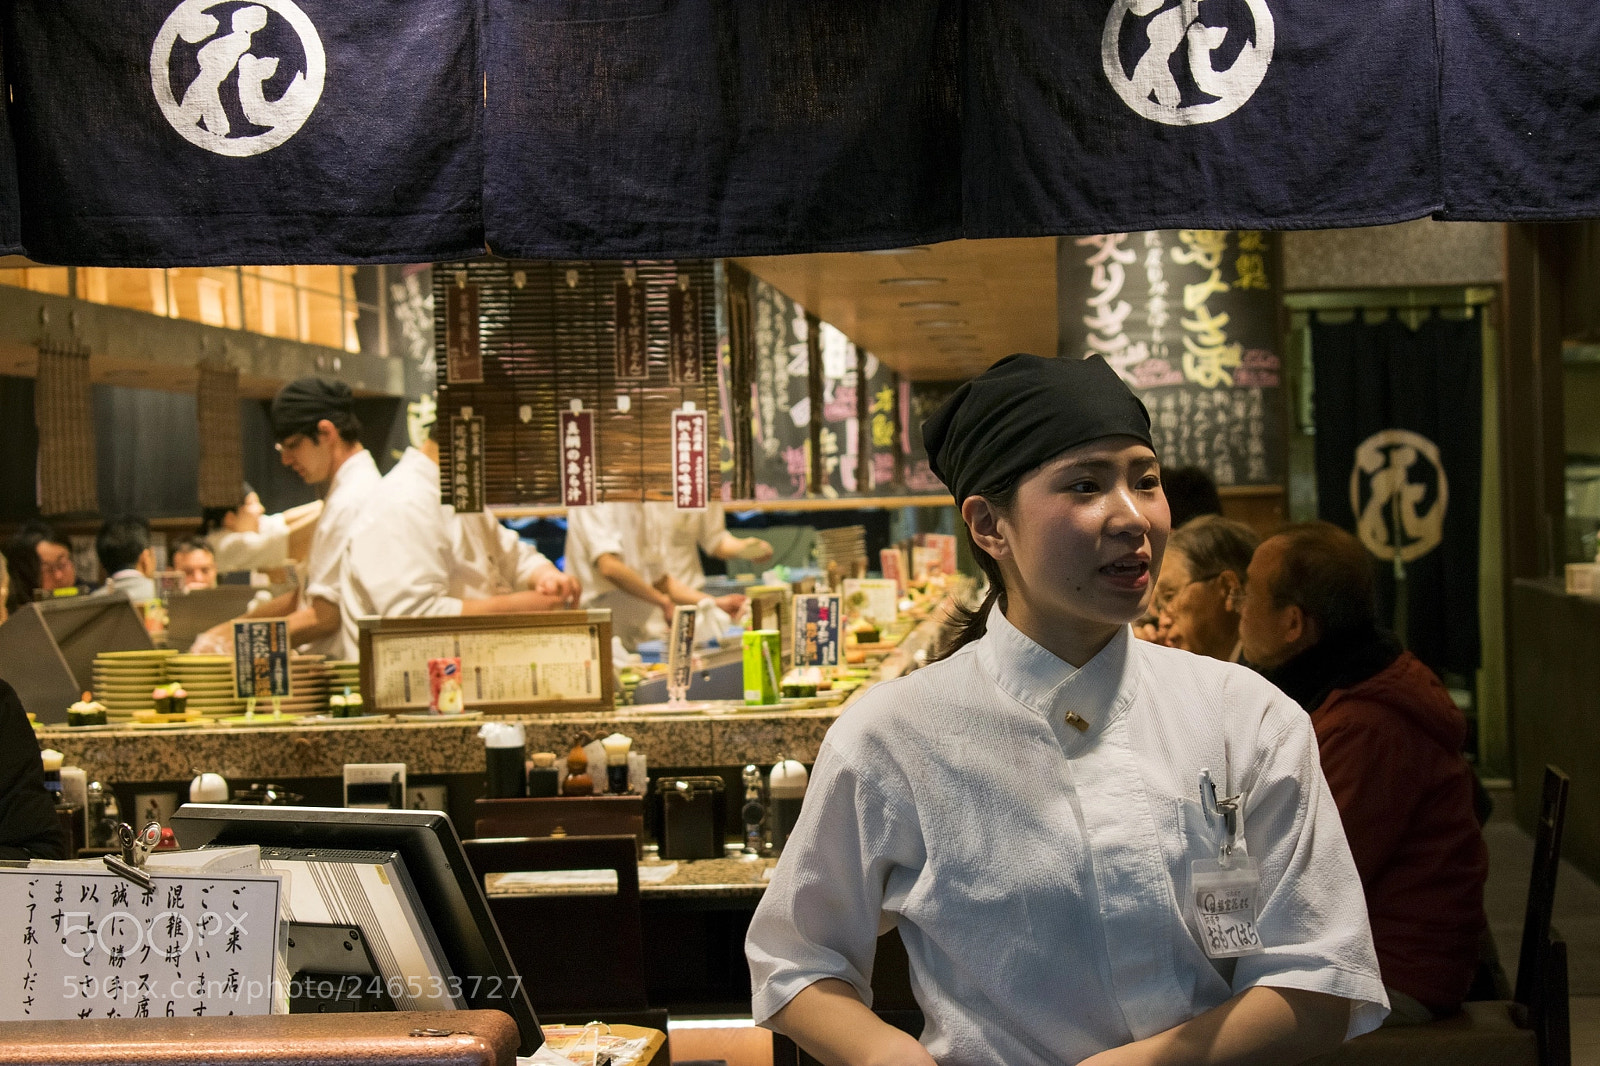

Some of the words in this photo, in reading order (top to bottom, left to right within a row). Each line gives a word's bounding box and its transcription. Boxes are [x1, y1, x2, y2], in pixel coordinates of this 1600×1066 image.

[22, 879, 39, 1015] ご了承くださ
[50, 880, 67, 945] ます。
[222, 885, 247, 1017] ご来店
